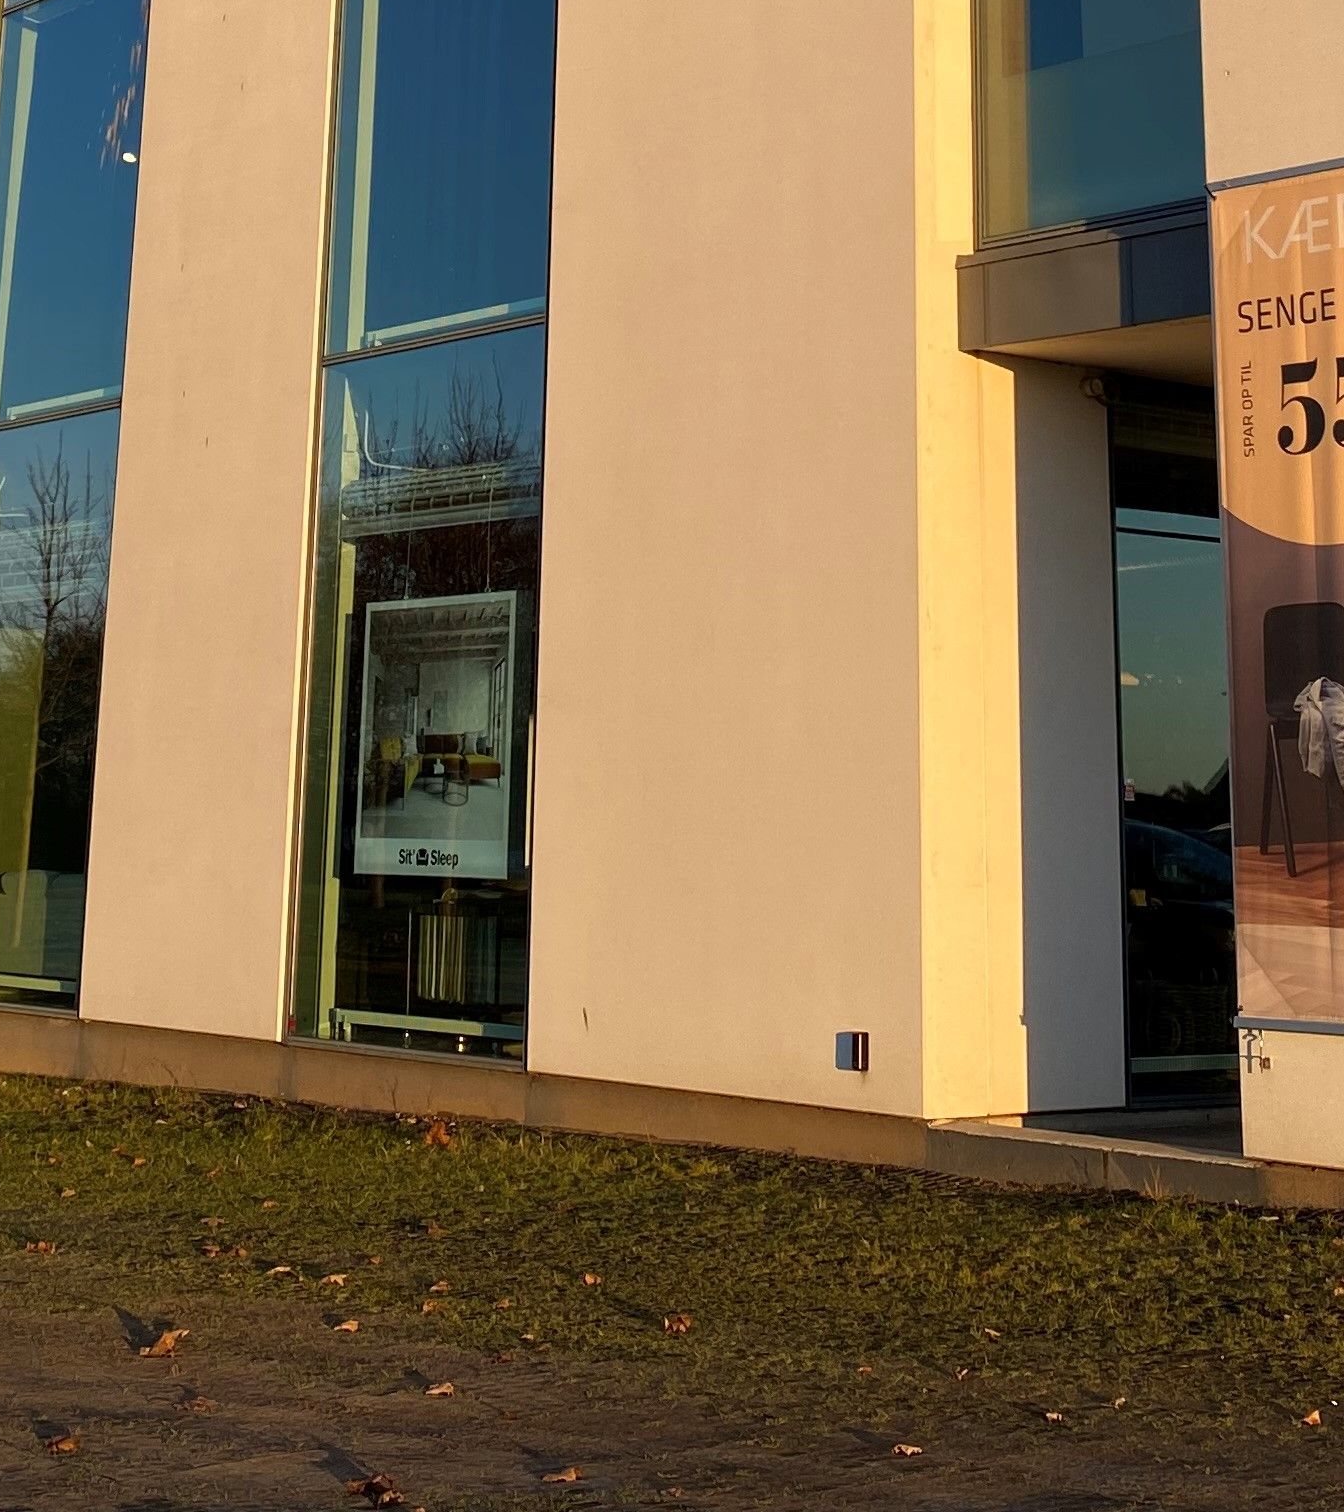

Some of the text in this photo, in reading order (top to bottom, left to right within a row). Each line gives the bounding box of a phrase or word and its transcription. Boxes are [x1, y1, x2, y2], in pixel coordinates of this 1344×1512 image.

[1237, 287, 1337, 334] SENGE
[1240, 360, 1256, 458] SPAR OP TIL
[430, 849, 459, 870] Sleep
